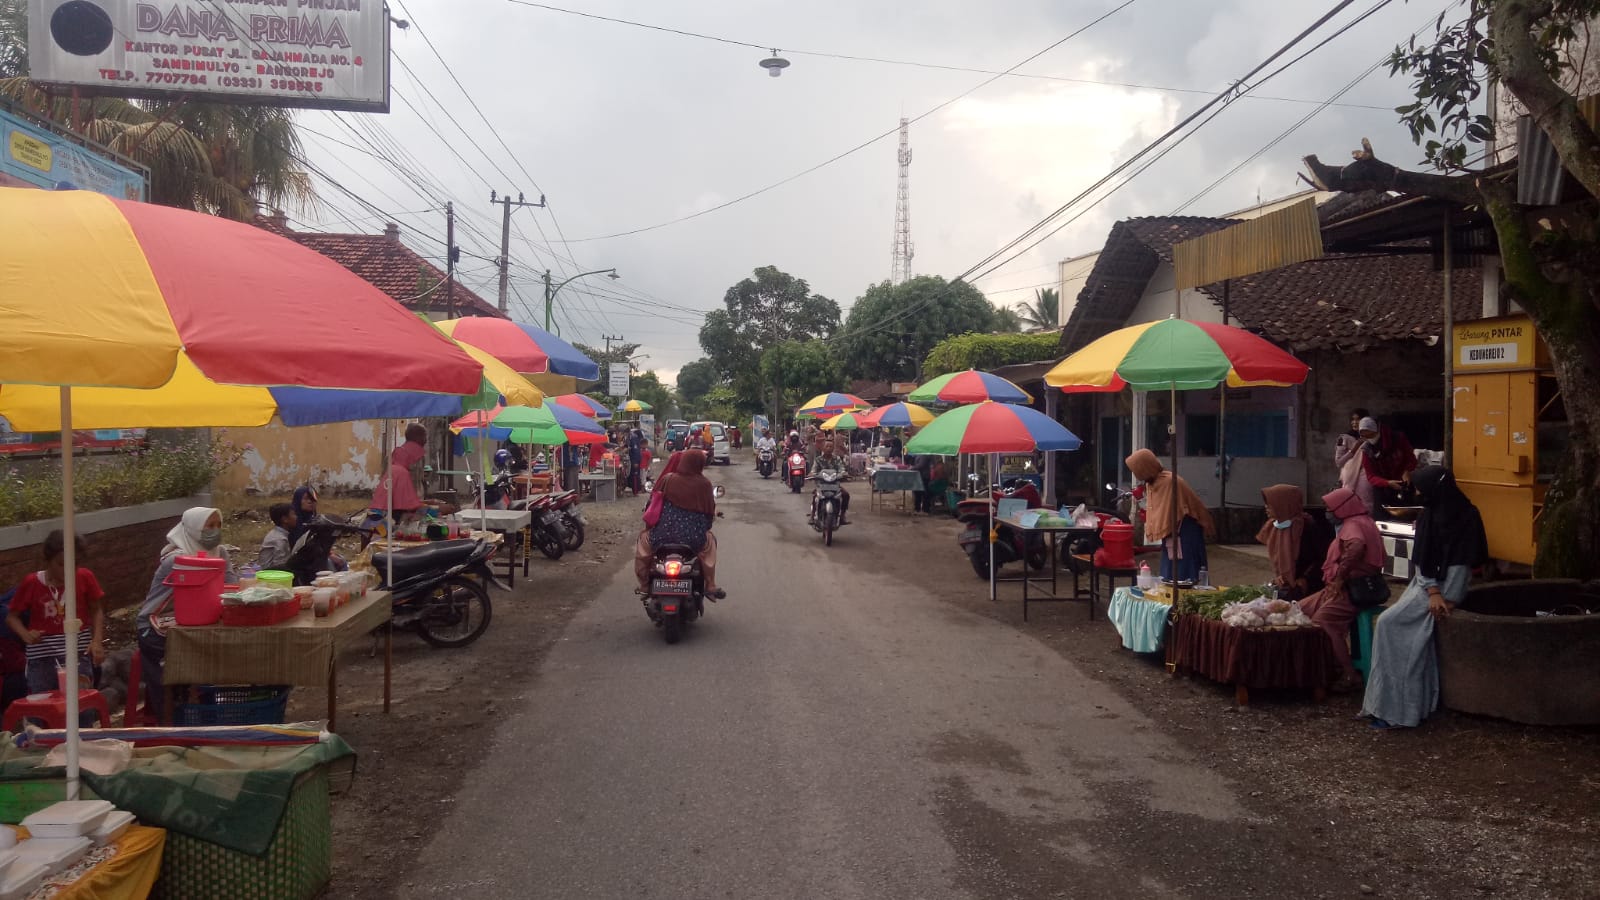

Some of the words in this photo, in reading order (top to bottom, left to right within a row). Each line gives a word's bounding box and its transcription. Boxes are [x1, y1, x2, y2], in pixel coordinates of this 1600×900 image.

[136, 3, 239, 42] DANA
[250, 13, 352, 49] PRIMA
[125, 40, 178, 55] KANTOR
[183, 44, 224, 58] PUSAT
[330, 54, 350, 66] NO.
[98, 68, 139, 82] TELP.
[152, 58, 240, 73] SAMBIMULYO
[256, 64, 334, 79] BANGOREJO
